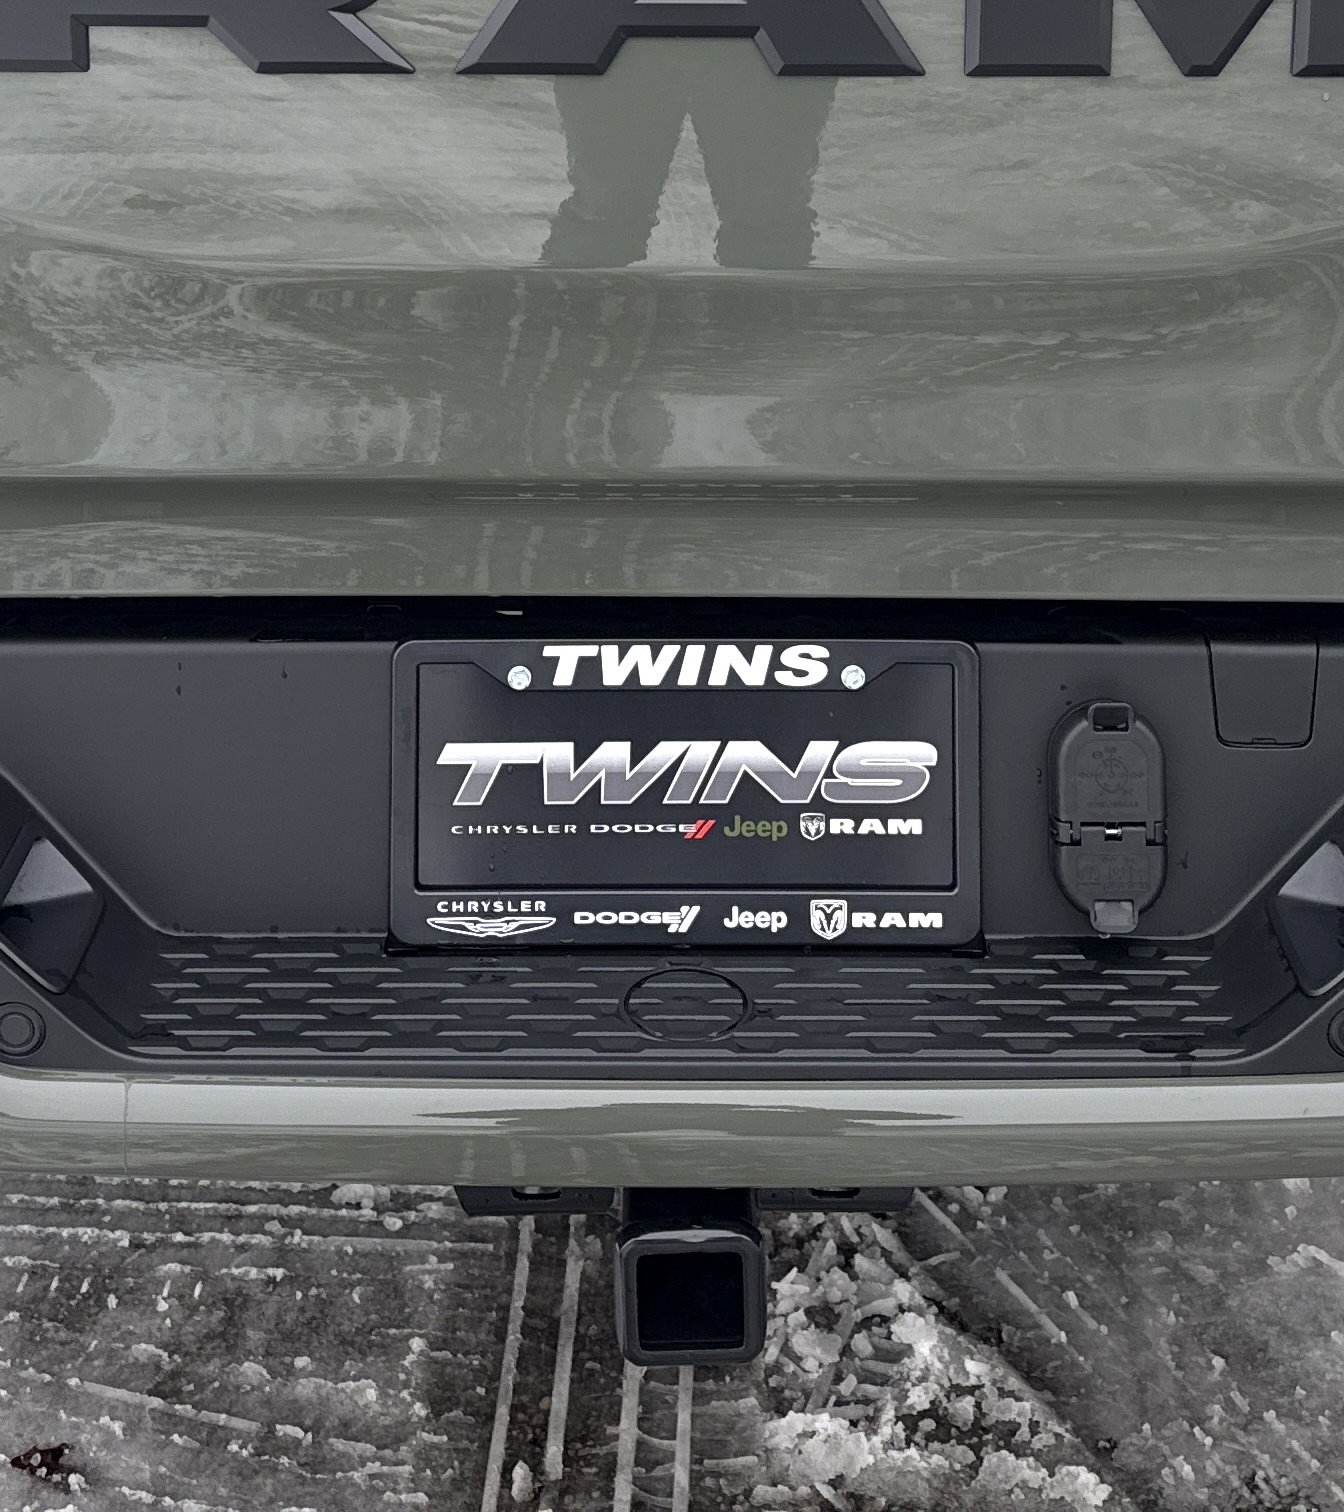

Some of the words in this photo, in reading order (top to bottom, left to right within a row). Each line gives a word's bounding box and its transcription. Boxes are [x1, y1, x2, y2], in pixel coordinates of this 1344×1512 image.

[542, 644, 830, 687] TWINS
[436, 740, 938, 806] TWINS
[451, 824, 577, 835] CHRYSLER
[590, 824, 697, 833] DODGE
[723, 815, 788, 841] Jeep
[830, 818, 923, 835] RAM
[436, 900, 547, 914] CHRYSLER
[574, 912, 682, 925] DODGE
[723, 906, 788, 932] Jeep
[852, 912, 943, 929] RAM
